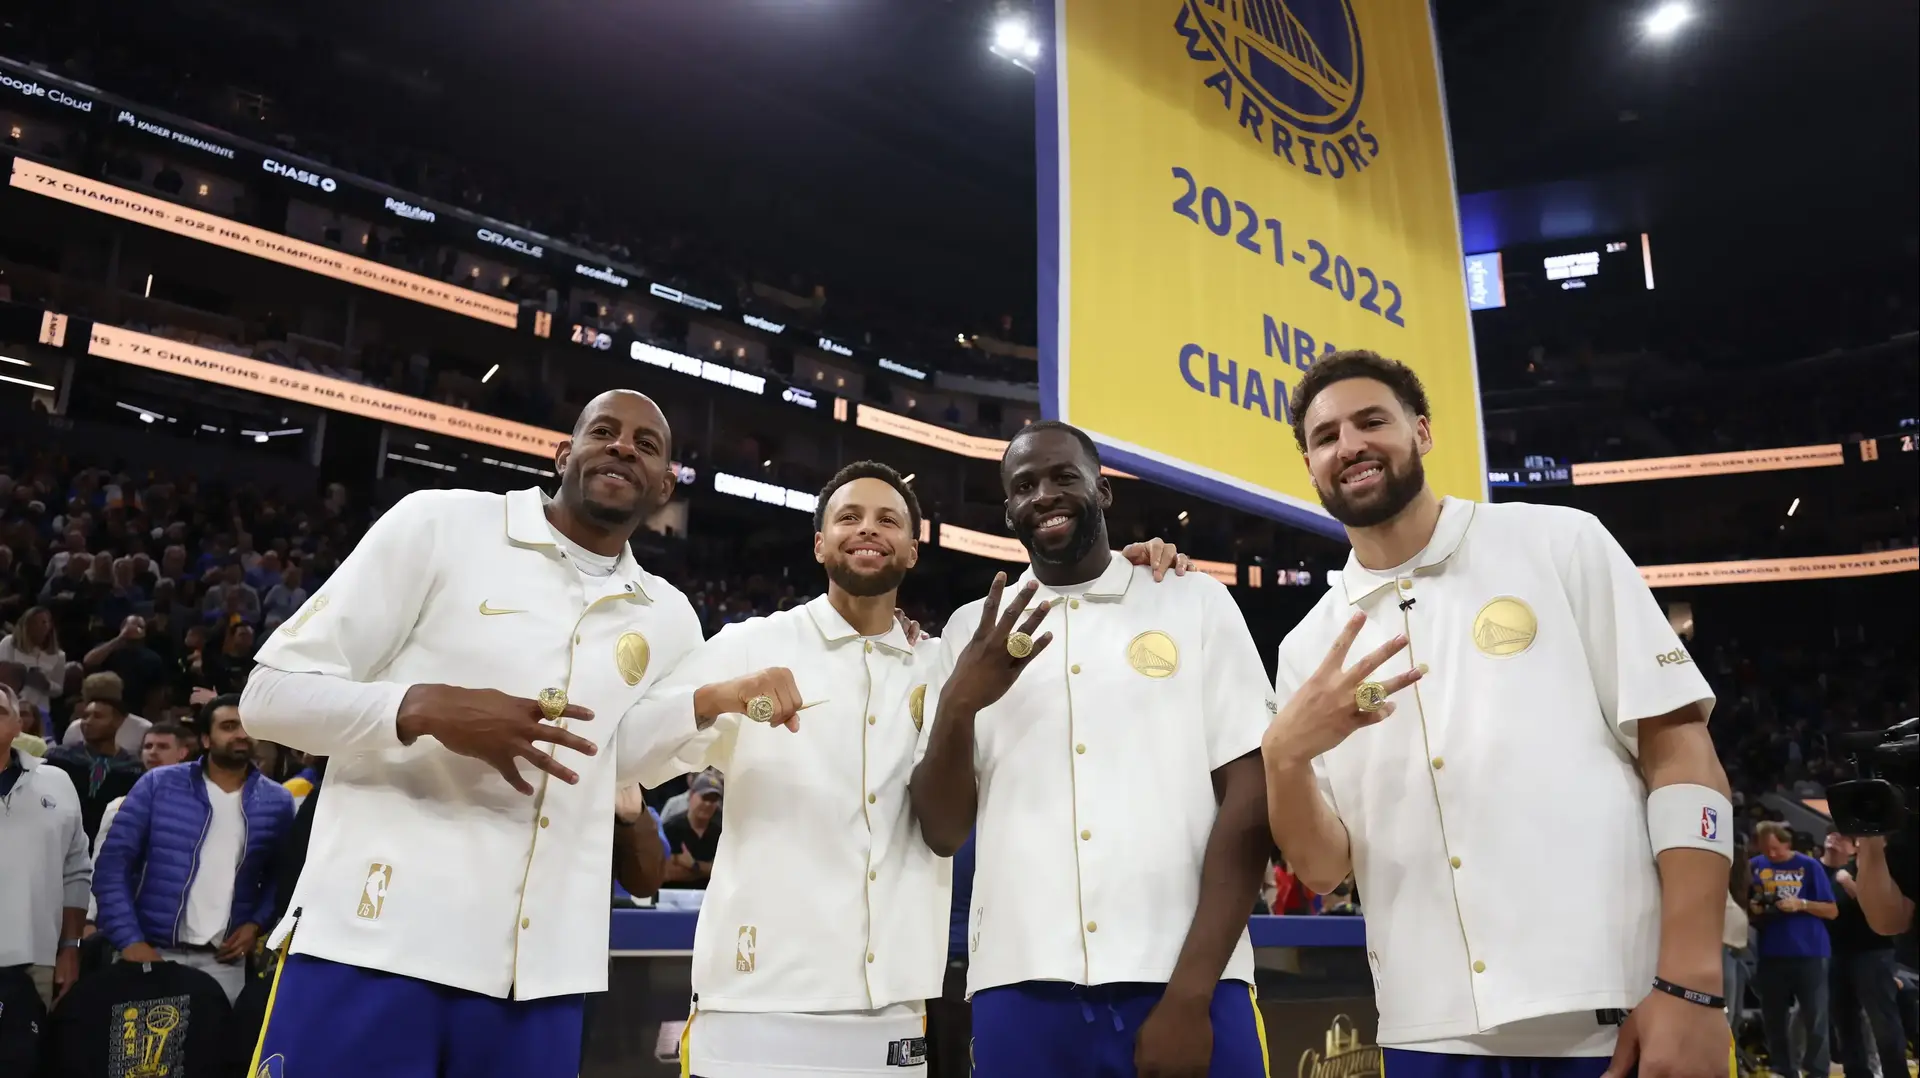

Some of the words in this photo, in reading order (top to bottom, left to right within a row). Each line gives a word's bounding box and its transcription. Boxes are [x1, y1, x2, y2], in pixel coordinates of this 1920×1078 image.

[0, 72, 46, 97] oogle
[48, 90, 93, 112] Cloud
[1174, 3, 1379, 179] WARRIORS
[137, 120, 170, 138] KAISER
[172, 131, 235, 160] PERMANENTE
[262, 158, 320, 188] CHASE
[385, 197, 436, 223] Rakuten
[35, 174, 58, 188] 7X
[62, 183, 165, 219] CHAMPIONS
[174, 215, 216, 233] 2022
[219, 227, 250, 243] NBA
[255, 238, 342, 270] CHAMPIONS
[352, 266, 408, 289] GOLDEN
[411, 283, 450, 300] STATE
[476, 228, 544, 258] ORACLE
[1171, 167, 1405, 327] 2021-2022
[130, 343, 151, 356] 7X
[157, 349, 259, 380] CHAMPIONS
[269, 375, 310, 394] 2022
[314, 386, 345, 400] NBA
[350, 394, 437, 421] CHAMPIONS
[448, 417, 502, 436] GOLDEN
[506, 431, 544, 447] STATE
[1789, 563, 1837, 573] GOLDEN
[1839, 560, 1875, 569] STATE
[1775, 873, 1804, 881] DAY
[358, 903, 371, 916] 75
[737, 960, 746, 971] 75
